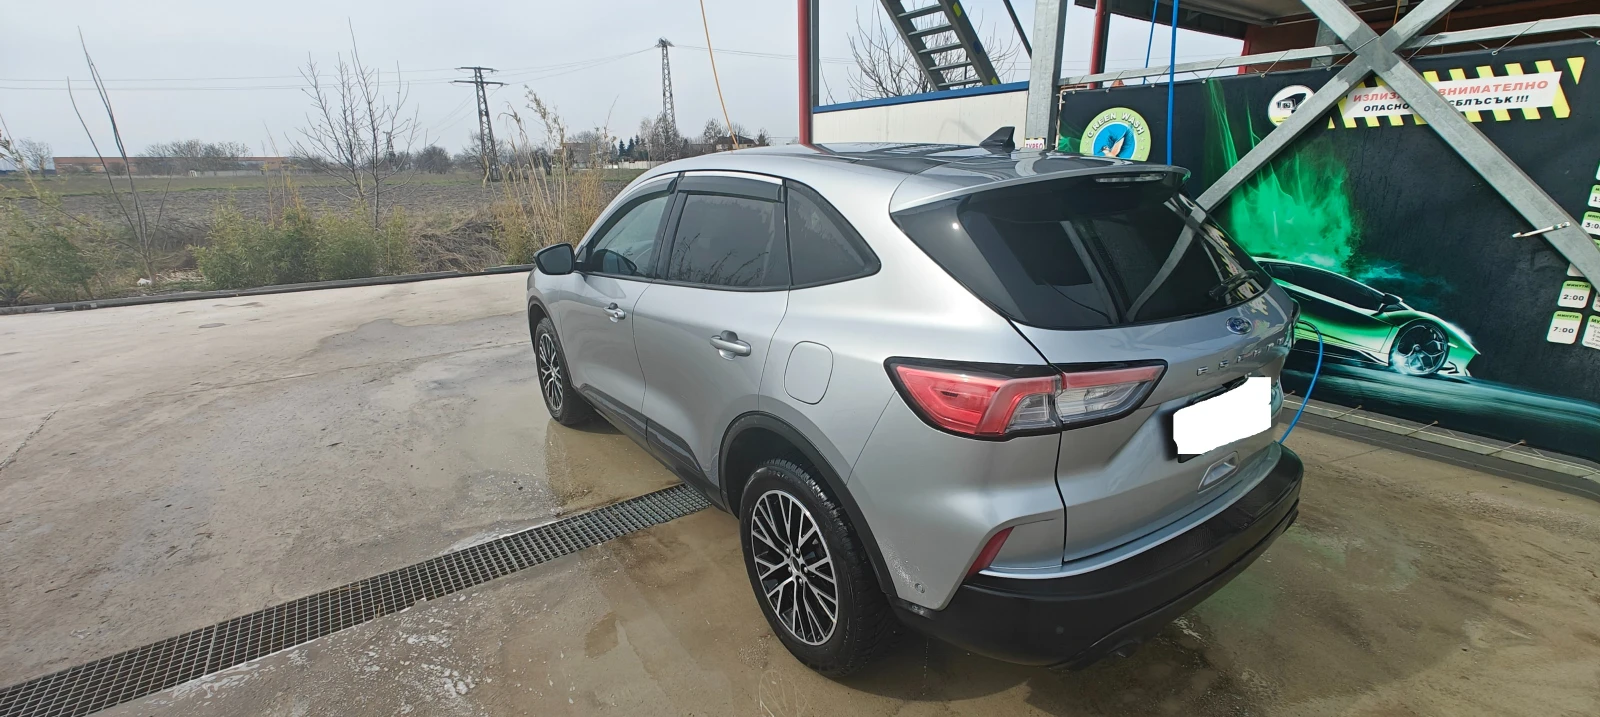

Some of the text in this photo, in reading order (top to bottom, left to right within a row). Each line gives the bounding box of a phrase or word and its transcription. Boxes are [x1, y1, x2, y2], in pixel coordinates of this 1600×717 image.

[1353, 80, 1549, 102] ИЗЛИЗ ВНИМАТЕЛНО
[1363, 102, 1410, 112] ОПАСНО
[1086, 111, 1145, 139] GREEN WASH
[1585, 222, 1600, 230] 3:0
[1562, 294, 1585, 302] 2:00
[1553, 326, 1575, 334] 7:00
